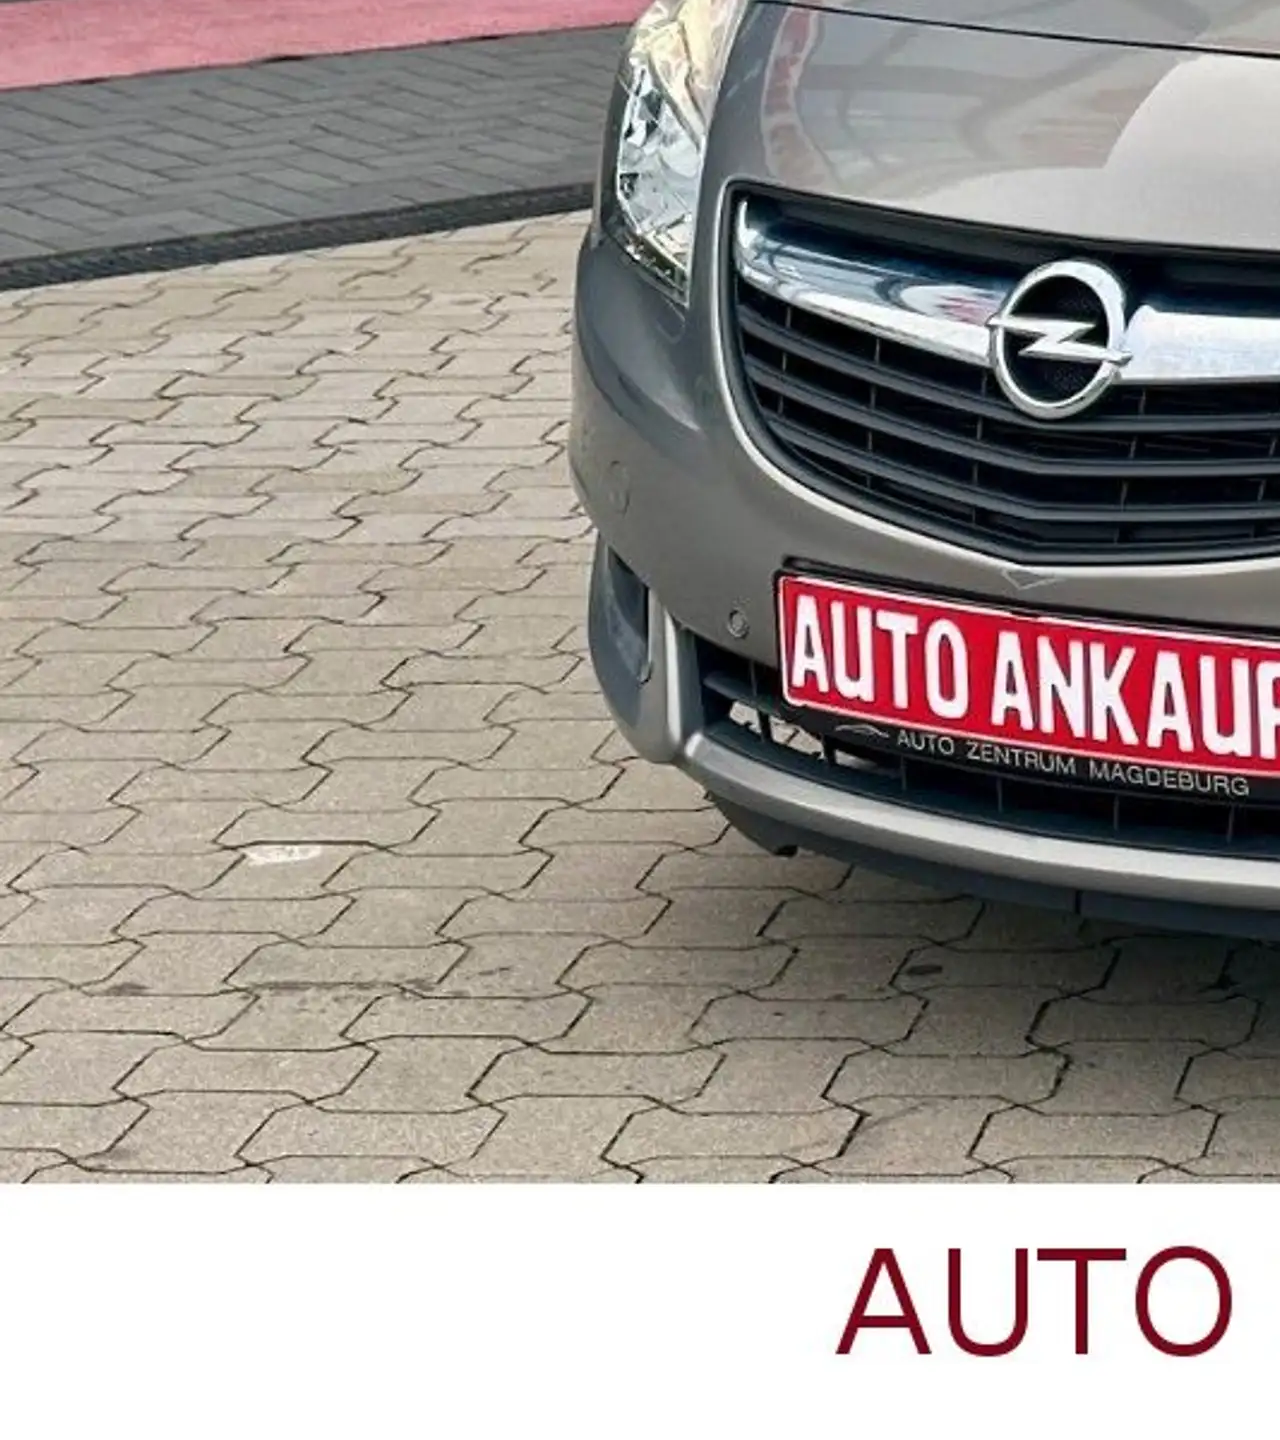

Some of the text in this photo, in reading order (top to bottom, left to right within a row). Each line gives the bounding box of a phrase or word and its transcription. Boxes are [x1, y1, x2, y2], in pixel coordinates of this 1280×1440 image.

[790, 594, 970, 720] AUTO
[896, 731, 1251, 797] AUTO ZENTRUM MAGDEBURG
